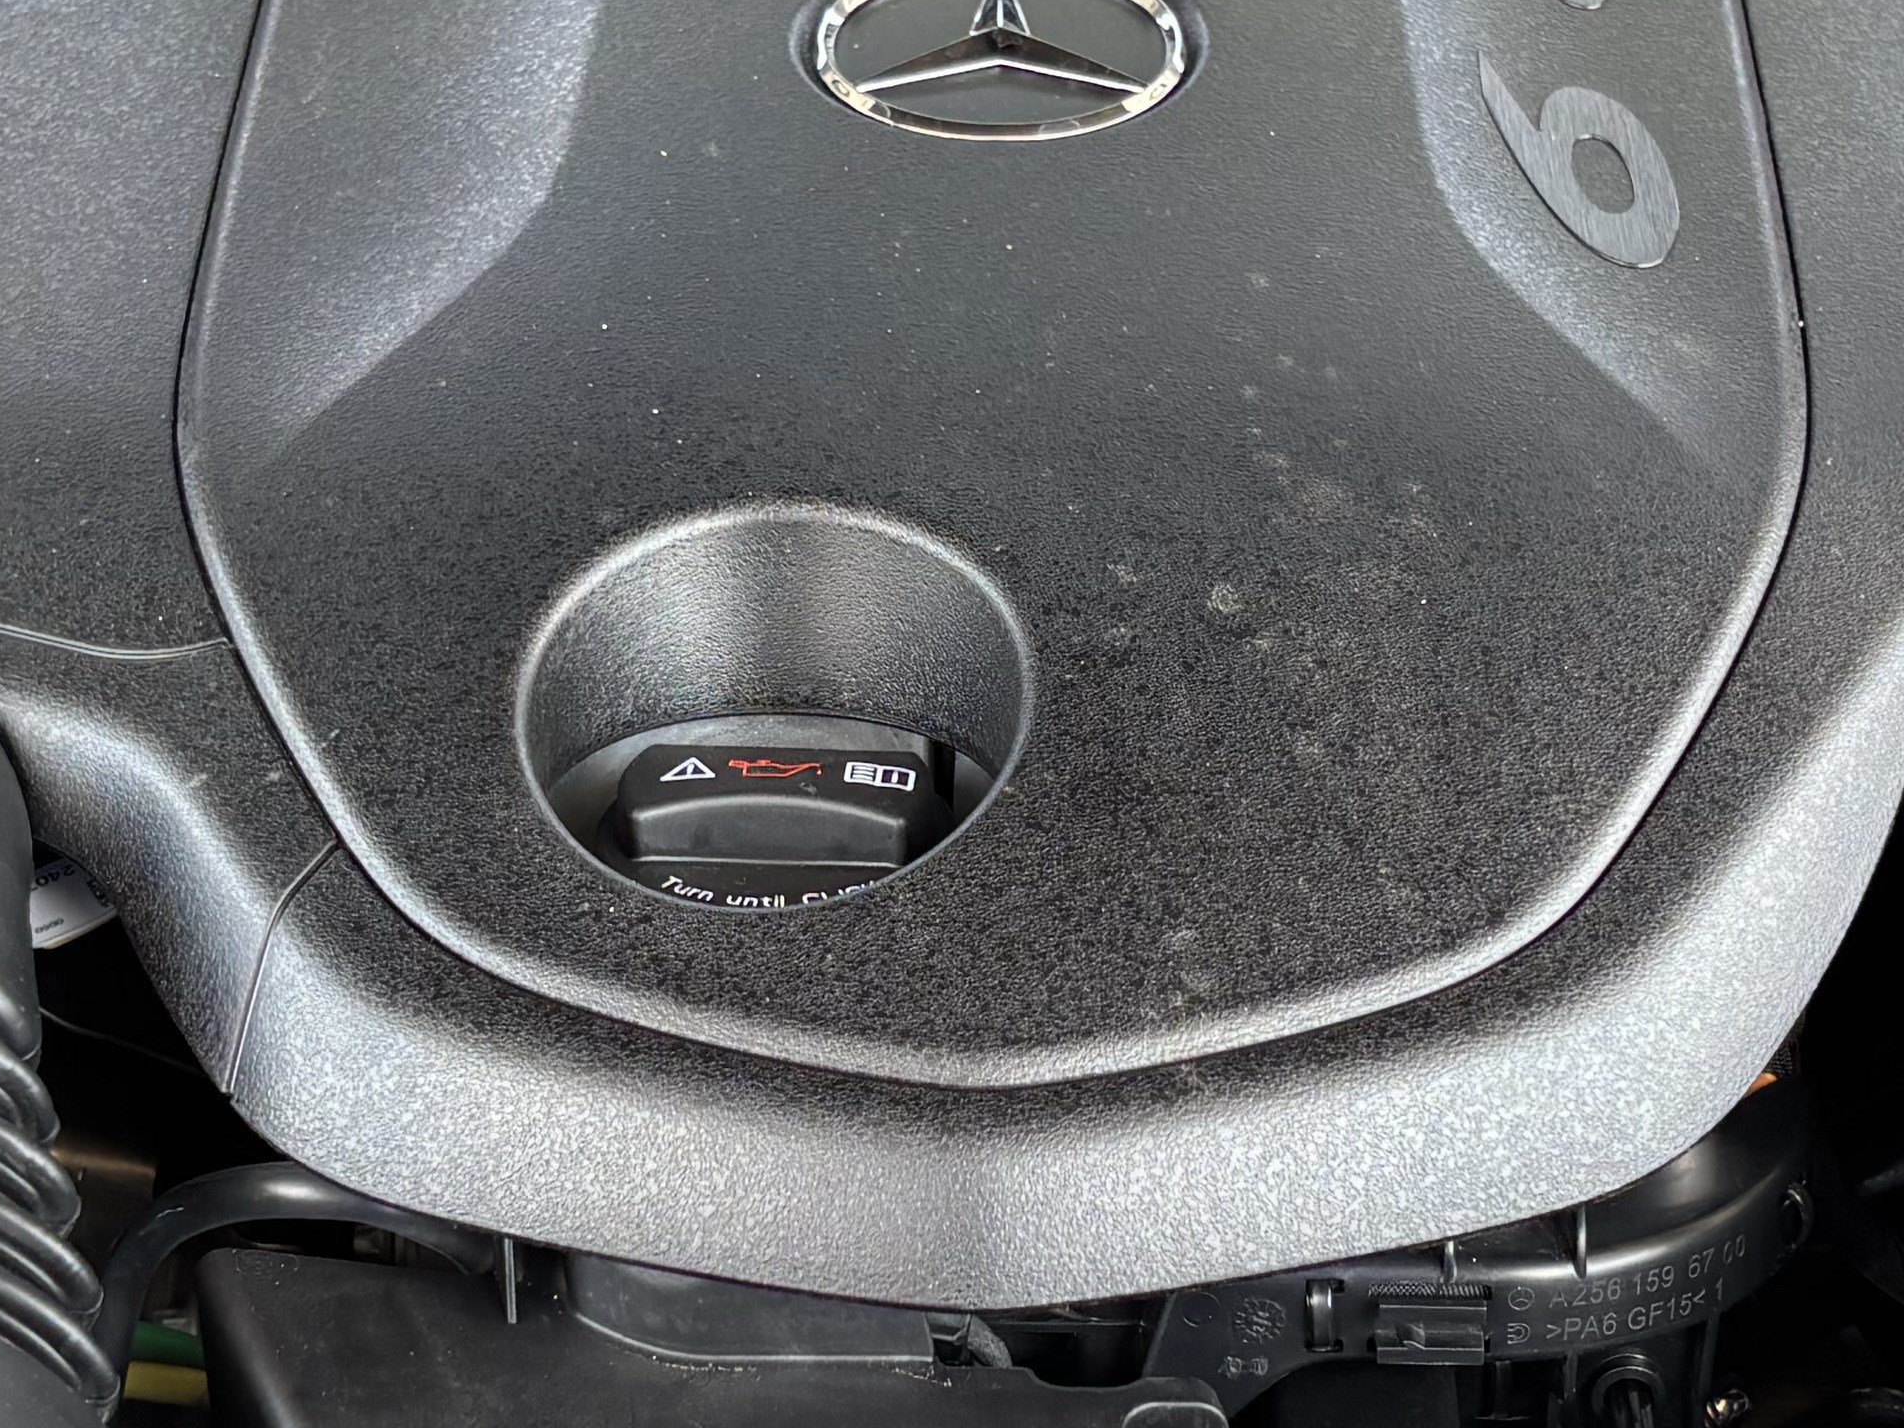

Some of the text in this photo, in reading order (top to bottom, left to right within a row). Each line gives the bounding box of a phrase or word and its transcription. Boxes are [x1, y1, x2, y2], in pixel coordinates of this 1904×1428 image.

[1478, 50, 1681, 268] 6
[661, 875, 786, 908] Turn until
[1634, 1264, 1675, 1296] 159
[1687, 1246, 1716, 1279] 67
[1722, 1233, 1747, 1265] 00
